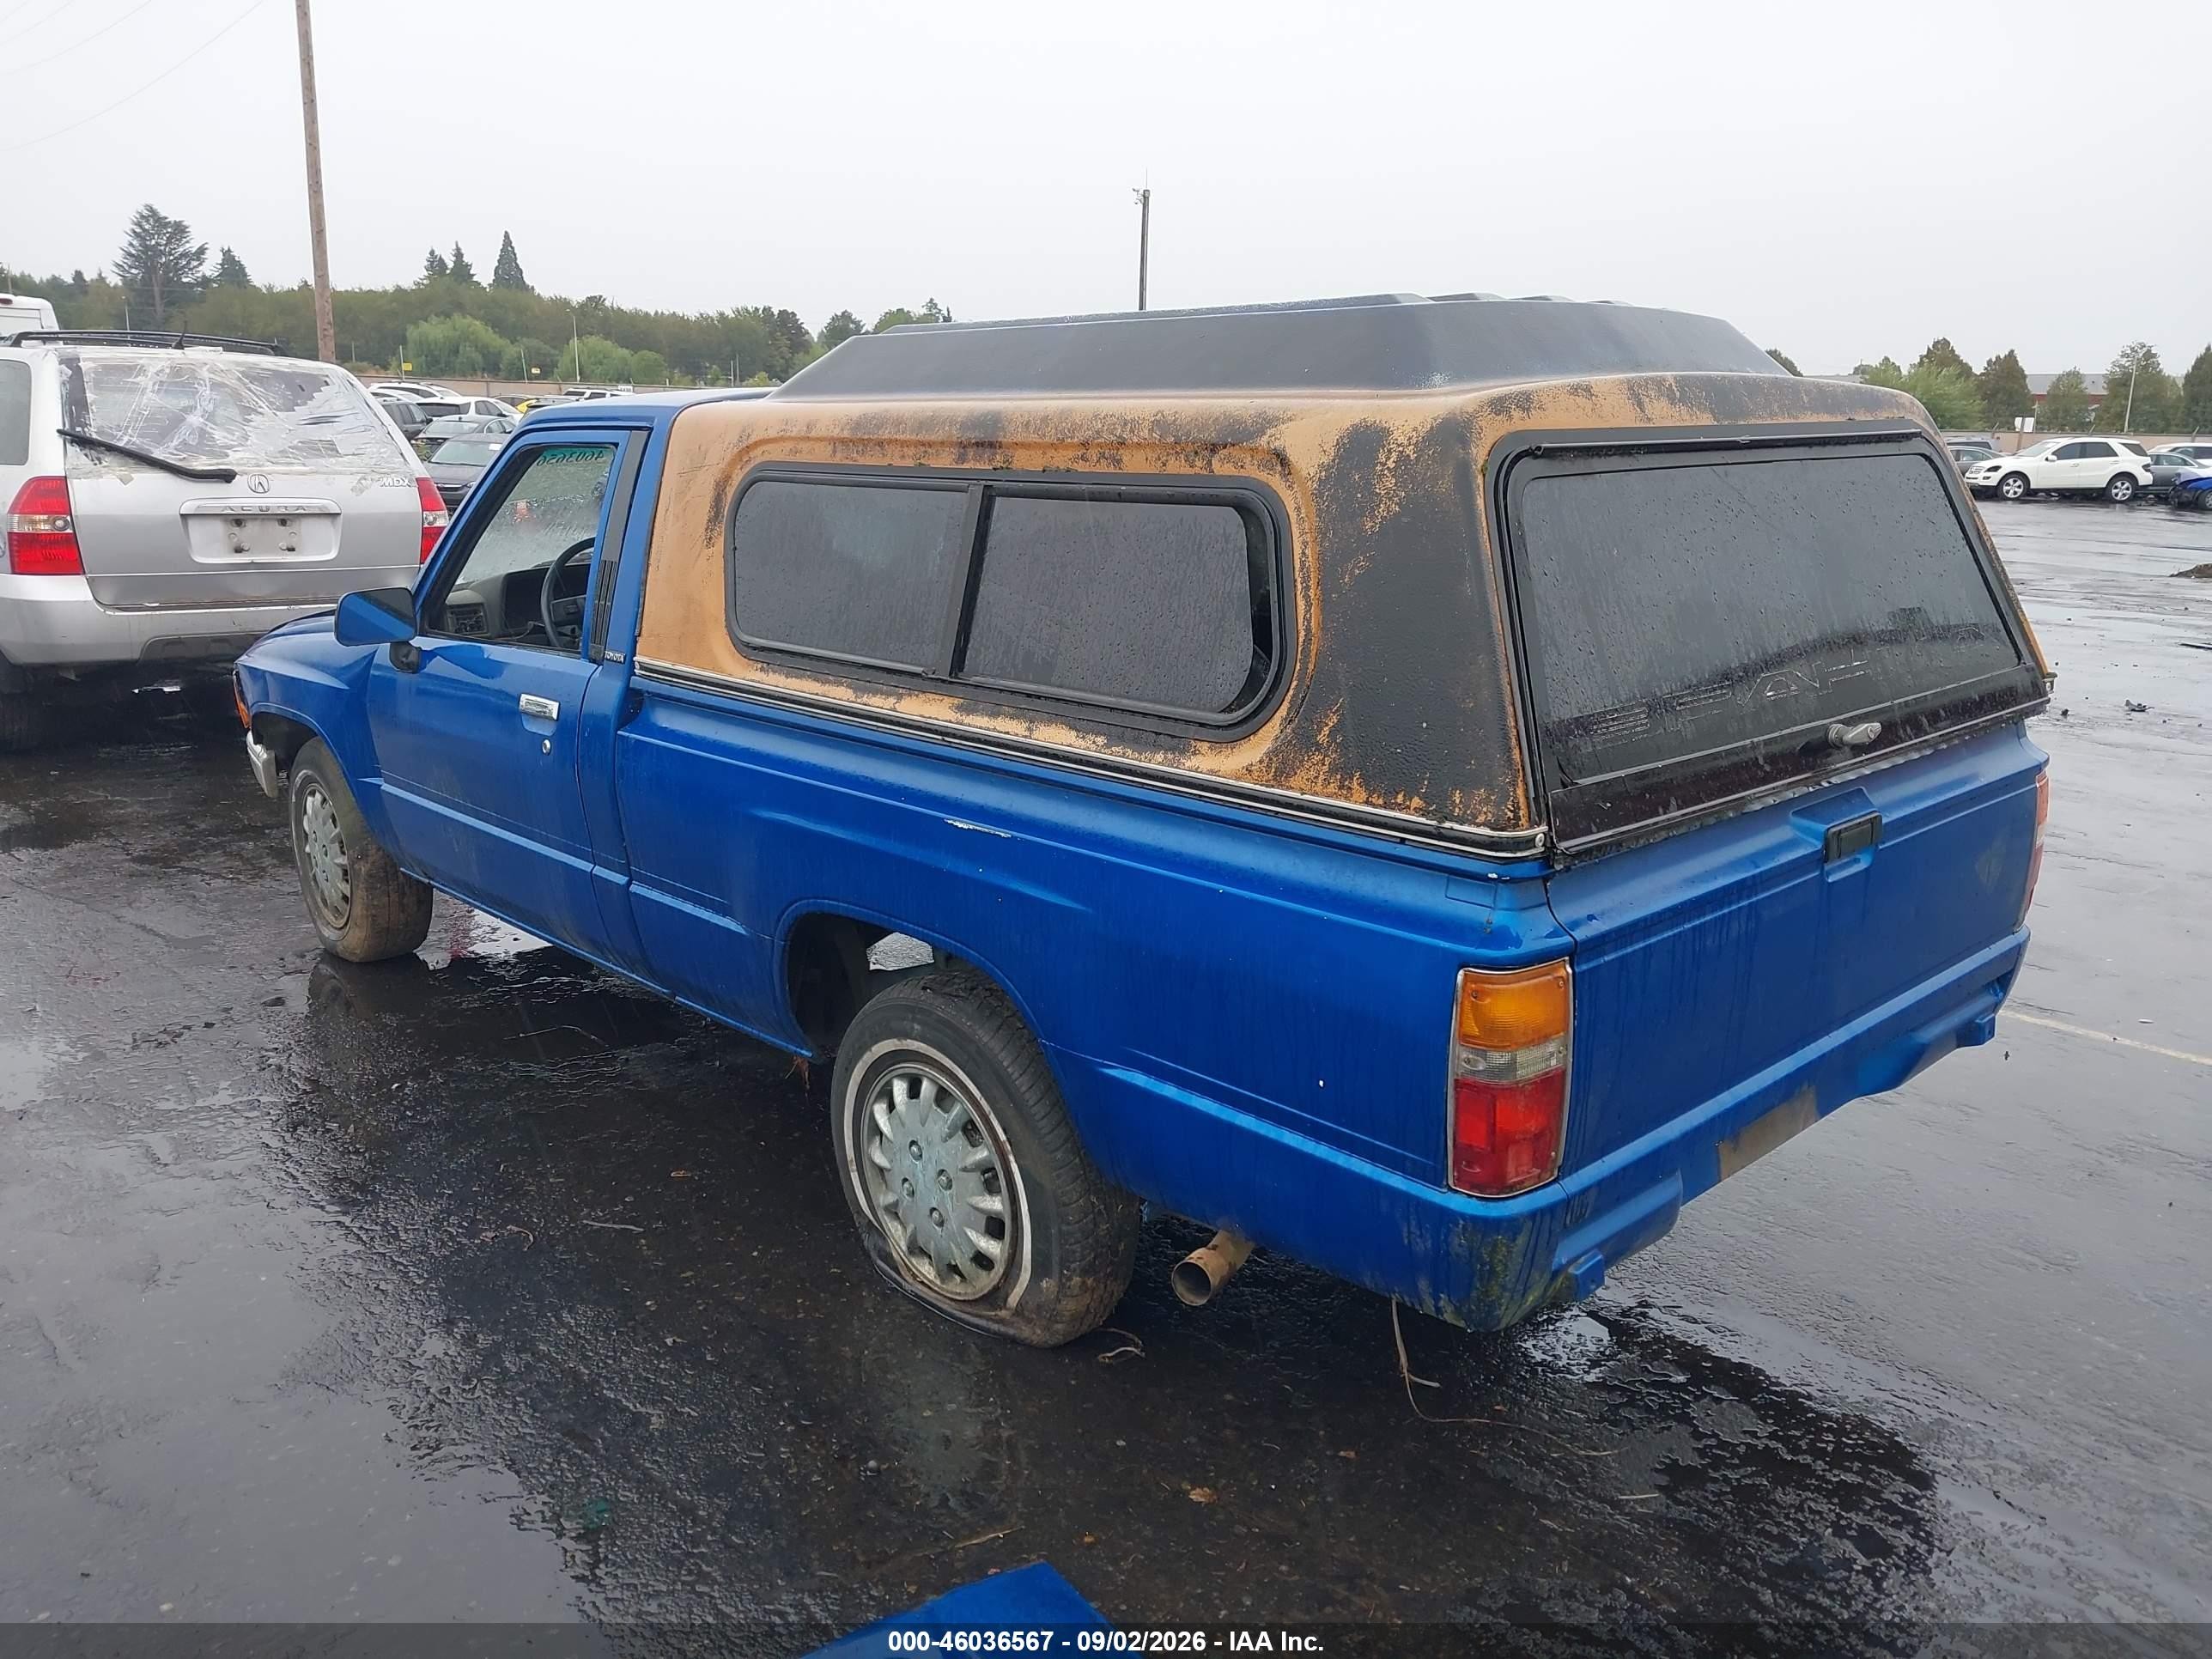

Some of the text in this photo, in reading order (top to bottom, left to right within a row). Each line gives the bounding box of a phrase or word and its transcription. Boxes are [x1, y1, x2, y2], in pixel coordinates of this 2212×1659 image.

[380, 477, 411, 488] MDX
[222, 505, 307, 514] ACURA
[605, 650, 626, 664] TOYOTA
